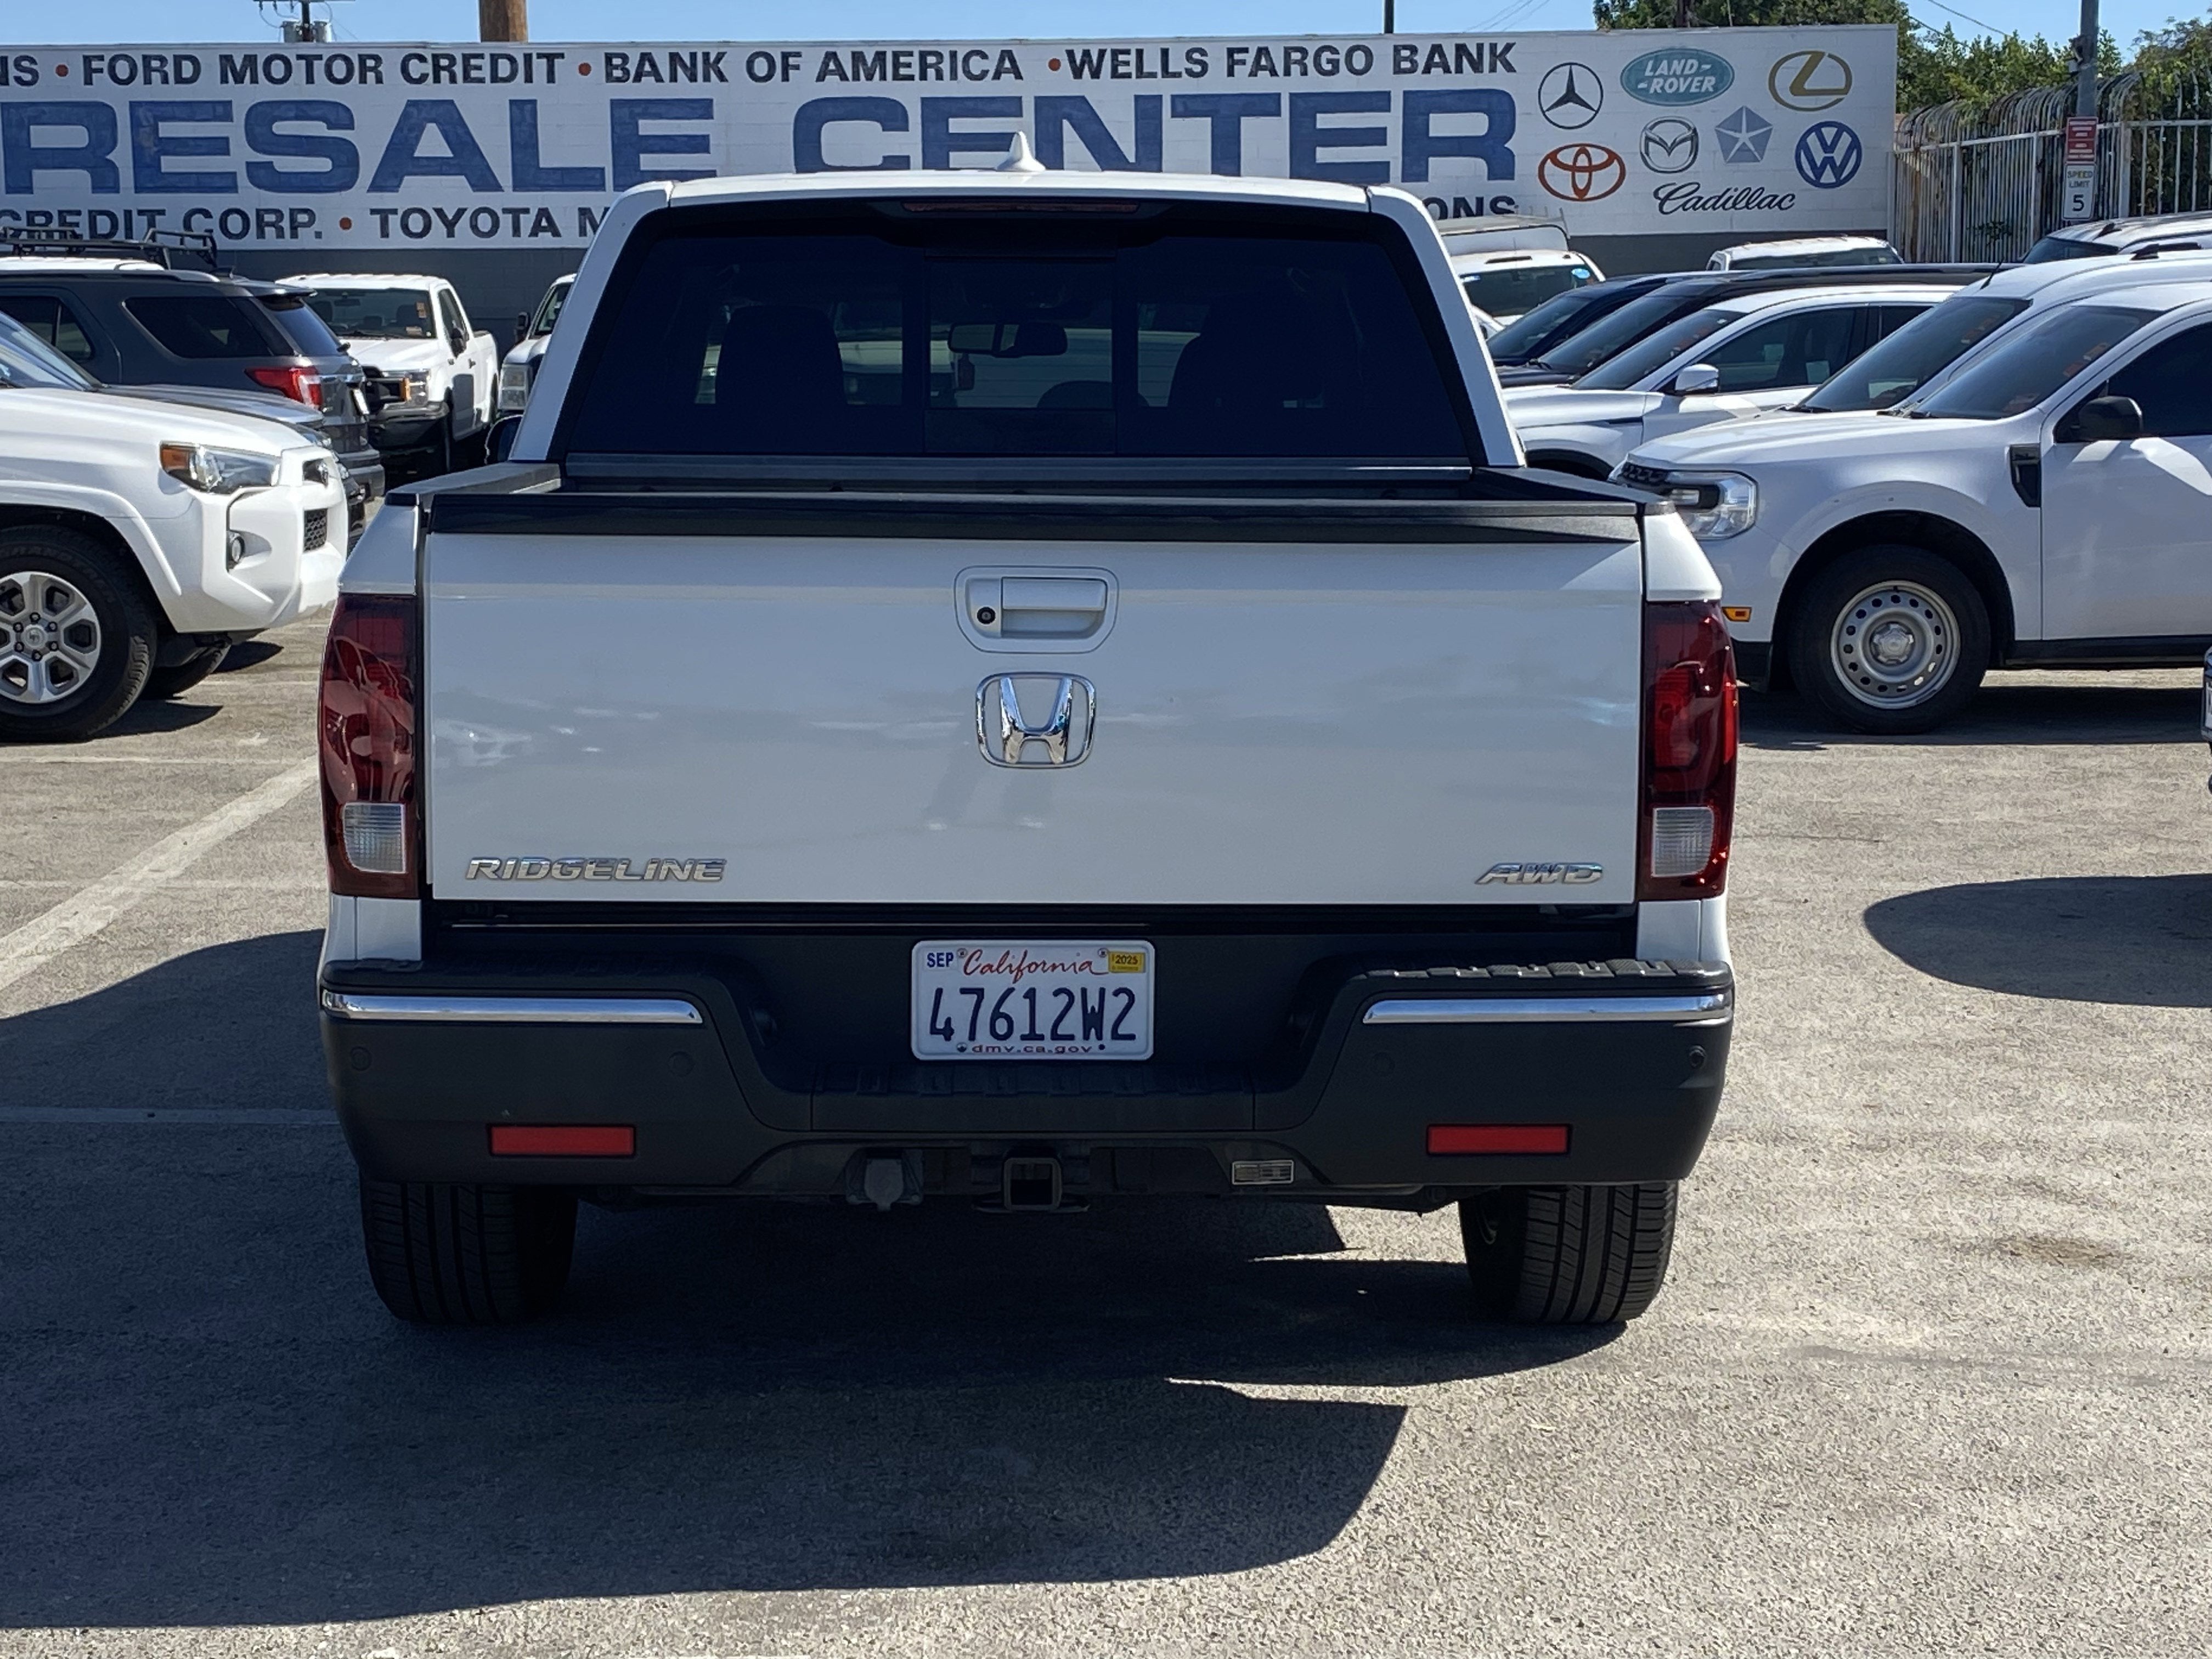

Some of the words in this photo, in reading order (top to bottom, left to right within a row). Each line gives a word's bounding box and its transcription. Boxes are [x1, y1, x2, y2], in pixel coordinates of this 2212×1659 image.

[83, 54, 201, 87] FORD
[219, 53, 384, 86] MOTOR
[400, 52, 565, 85] CREDIT
[604, 51, 729, 84] BANK
[746, 50, 803, 83] OF
[815, 49, 1024, 82] AMERICA
[1065, 47, 1209, 80] WELLS
[1226, 44, 1374, 78] FARGO
[1392, 42, 1517, 76] BANK
[1, 98, 717, 194] RESALE
[793, 88, 1516, 184] CENTER
[2067, 170, 2093, 178] SPEED
[2068, 180, 2090, 188] LIMIT
[1422, 196, 1515, 220] ONS
[1653, 182, 1797, 216] Cadillac
[2072, 194, 2085, 212] 5
[183, 207, 323, 240] CORP.
[369, 206, 562, 239] TOYOTA
[466, 856, 727, 882] RIDGELINE
[1474, 862, 1604, 884] AWD
[927, 952, 954, 968] SEP
[963, 949, 1109, 984] California
[1115, 955, 1138, 965] 2025
[929, 987, 1137, 1042] 47612W2
[972, 1043, 1092, 1054] dmv.ca.gov
